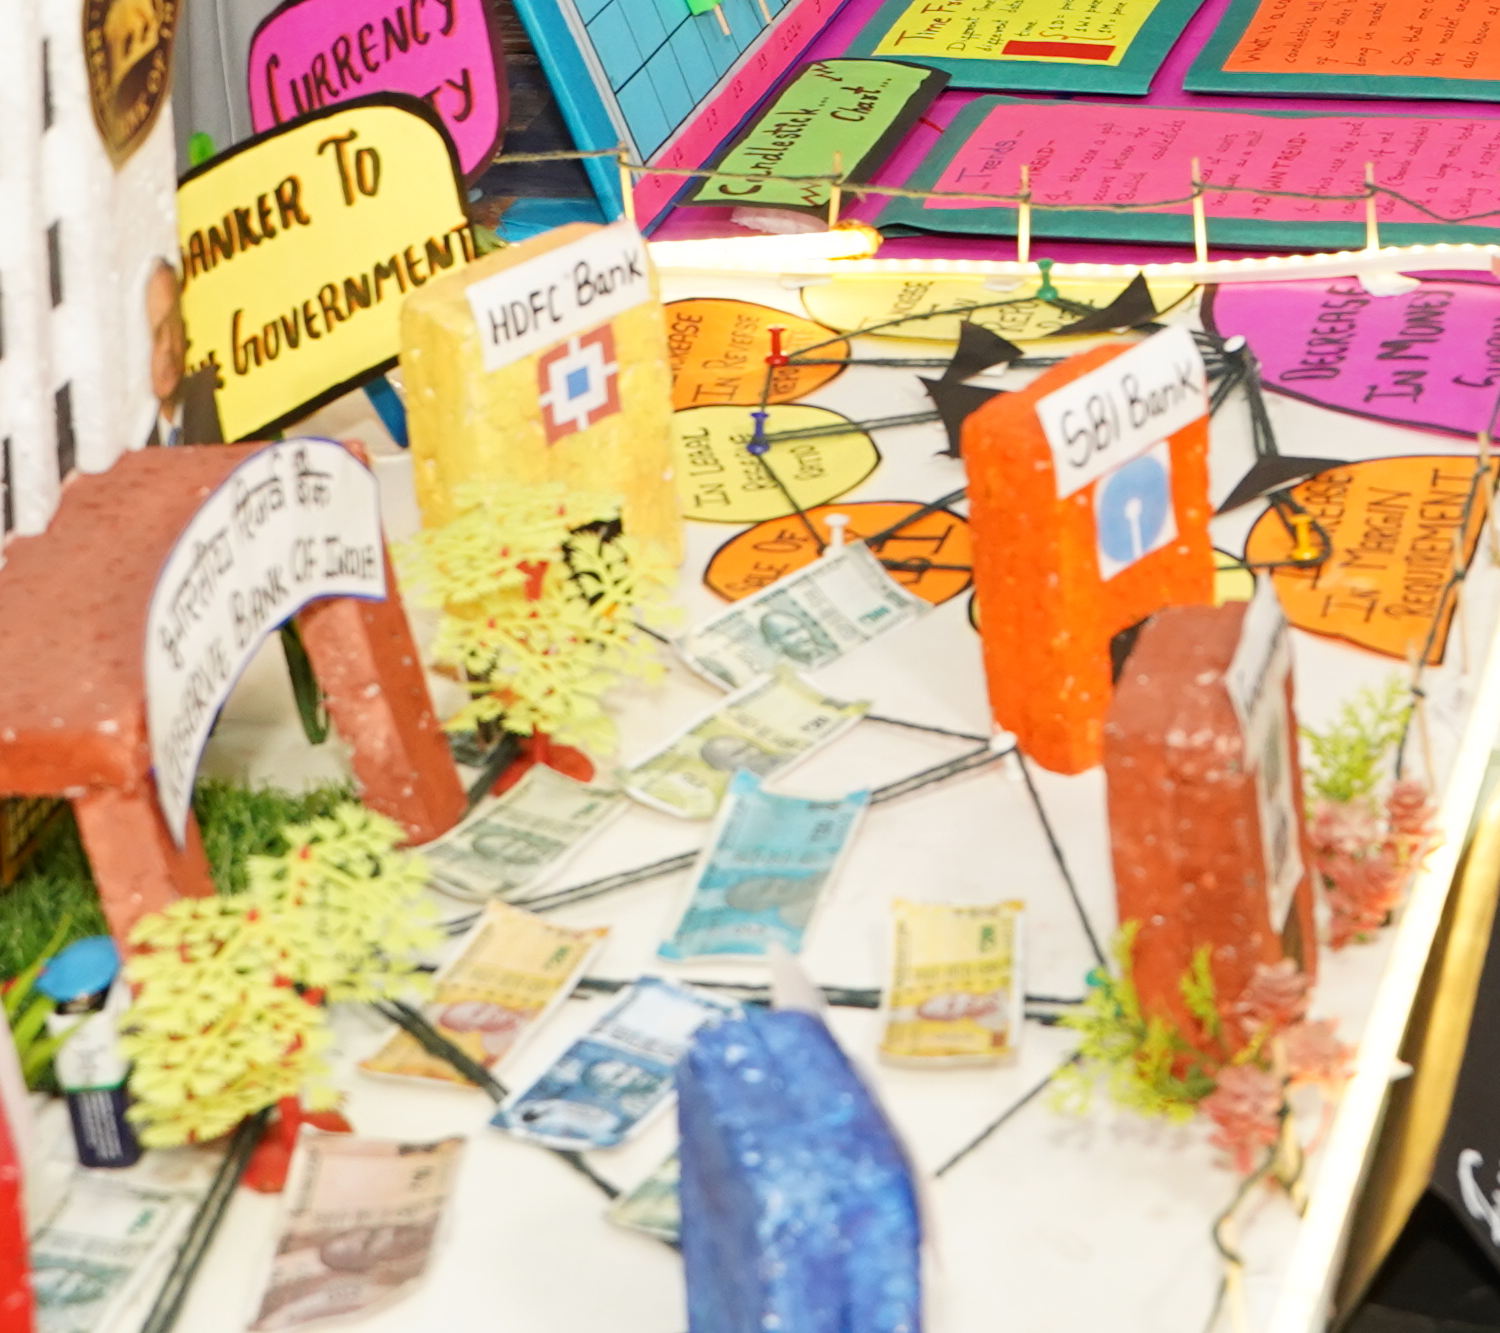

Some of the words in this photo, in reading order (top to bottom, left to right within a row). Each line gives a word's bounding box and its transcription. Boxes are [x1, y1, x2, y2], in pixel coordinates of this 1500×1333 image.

[893, 17, 953, 47] Time
[231, 220, 479, 376] GOVERNMENT
[488, 283, 562, 347] HDFC
[1279, 285, 1370, 382] DECREASE
[1060, 390, 1121, 469] SBI
[228, 565, 289, 649] BANK
[288, 537, 318, 583] OF
